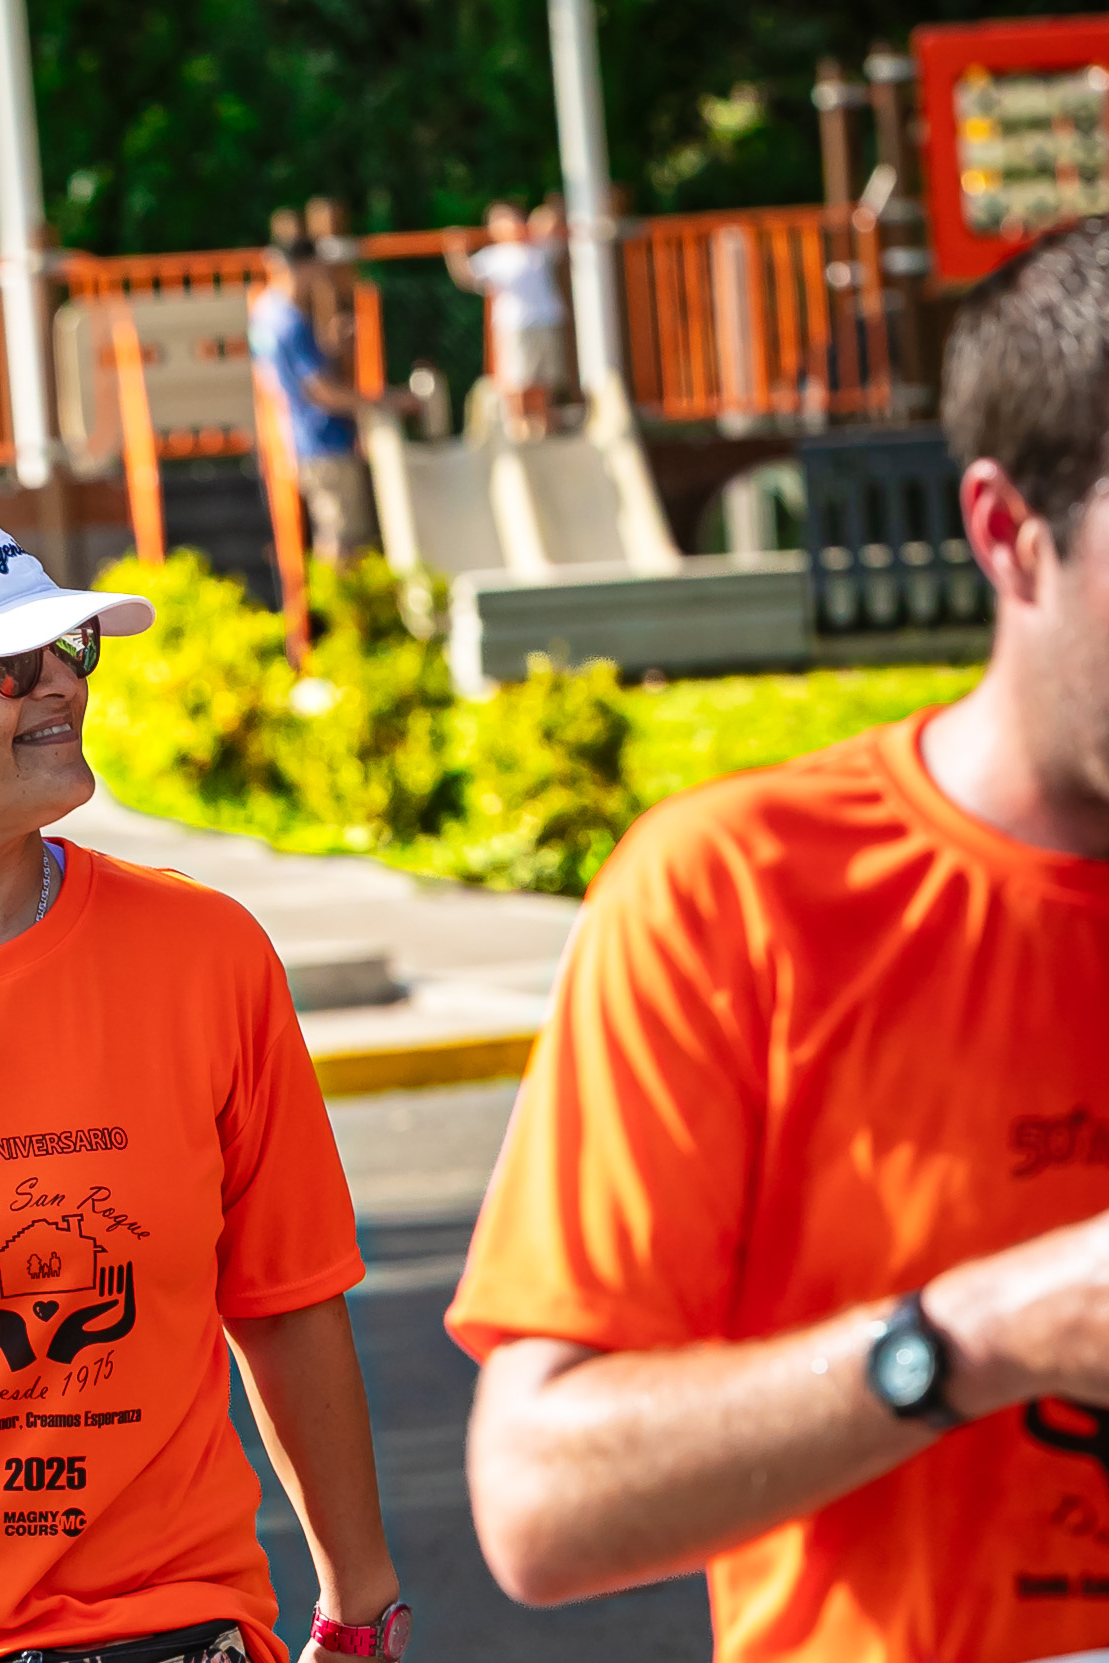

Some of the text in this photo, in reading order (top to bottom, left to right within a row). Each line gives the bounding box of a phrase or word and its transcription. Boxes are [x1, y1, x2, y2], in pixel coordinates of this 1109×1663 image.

[9, 1177, 66, 1212] San
[77, 1186, 151, 1240] Roque
[62, 1350, 115, 1396] 1975
[25, 1412, 81, 1428] Creamos
[84, 1408, 142, 1428] Esperanza
[3, 1456, 87, 1491] 2025
[3, 1510, 60, 1524] MAGNY
[4, 1523, 59, 1537] COURS
